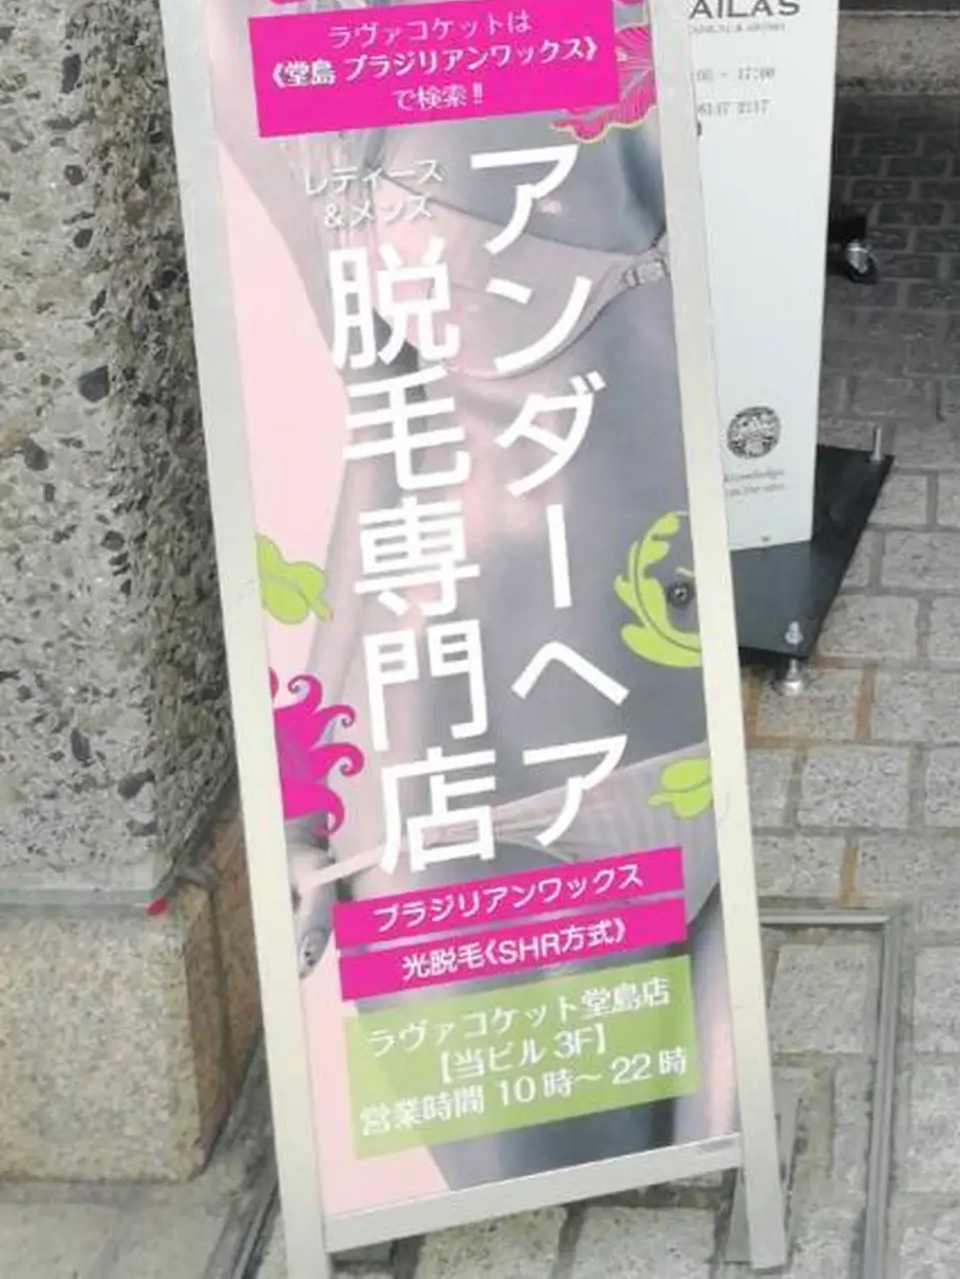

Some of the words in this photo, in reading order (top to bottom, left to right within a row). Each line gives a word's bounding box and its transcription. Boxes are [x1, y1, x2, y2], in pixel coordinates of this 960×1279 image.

[328, 9, 533, 49] ラヴァコケットは
[304, 158, 444, 197] レディース
[469, 144, 629, 848] アンダーヘア
[326, 236, 497, 876] 脱毛専門店
[374, 863, 644, 933] ブラジリアンワックス
[369, 976, 671, 1057] ラヴァコケット堂島店
[359, 1084, 485, 1136] 営業時間
